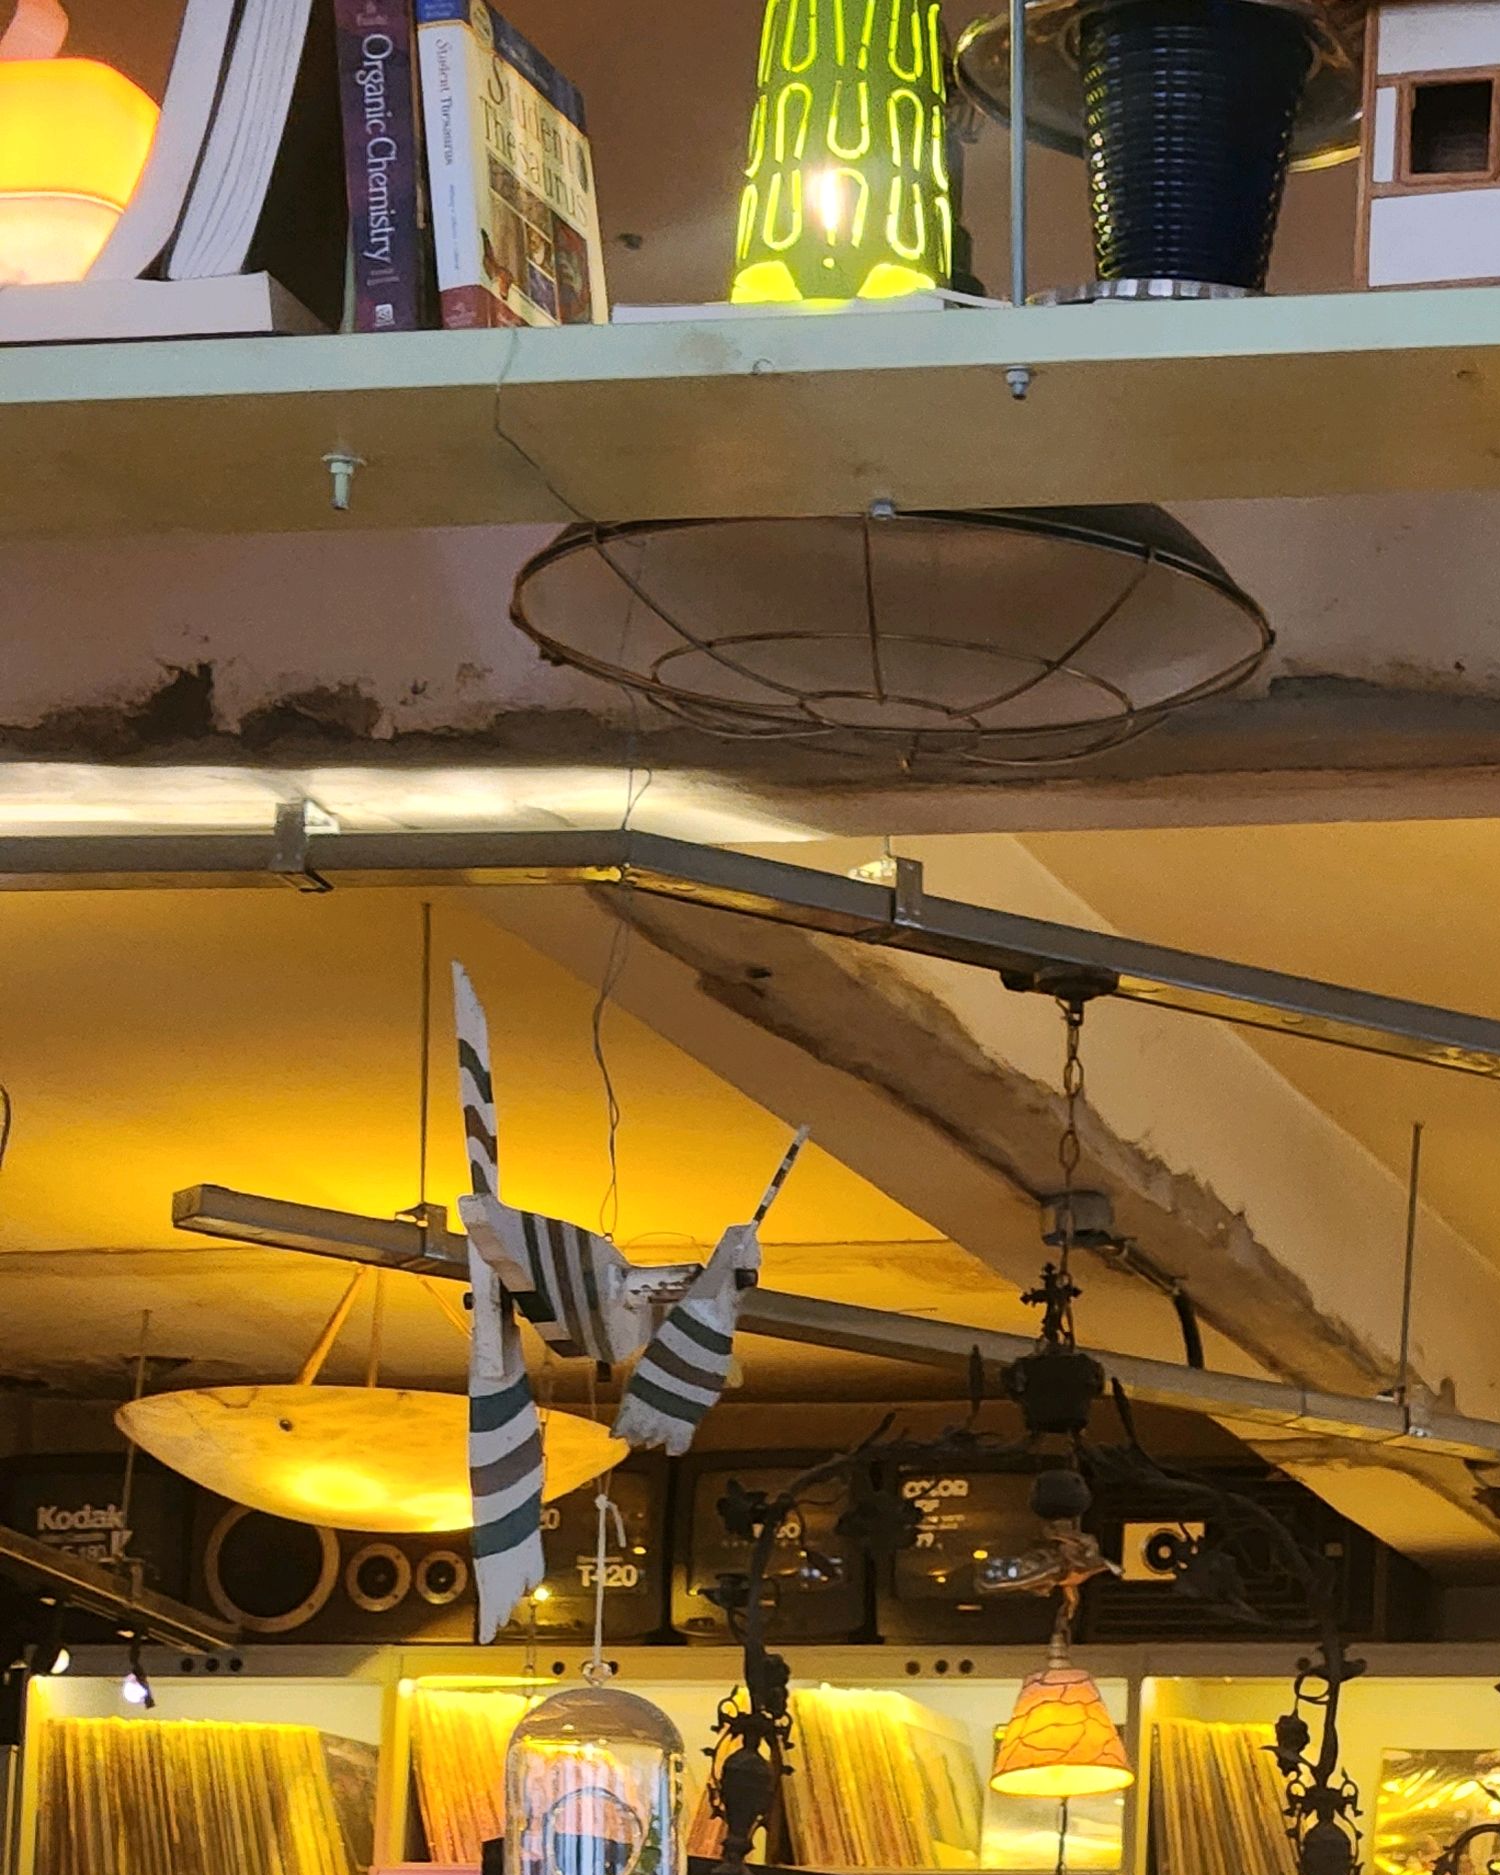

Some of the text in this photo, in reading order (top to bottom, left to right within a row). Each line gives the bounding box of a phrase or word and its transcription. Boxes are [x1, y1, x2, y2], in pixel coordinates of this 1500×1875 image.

[435, 37, 451, 93] Student
[354, 32, 399, 264] Organic Chemistry
[487, 56, 572, 174] Student
[480, 95, 587, 227] Thesaurus
[37, 1503, 125, 1531] Kodak
[576, 1564, 638, 1588] T-20
